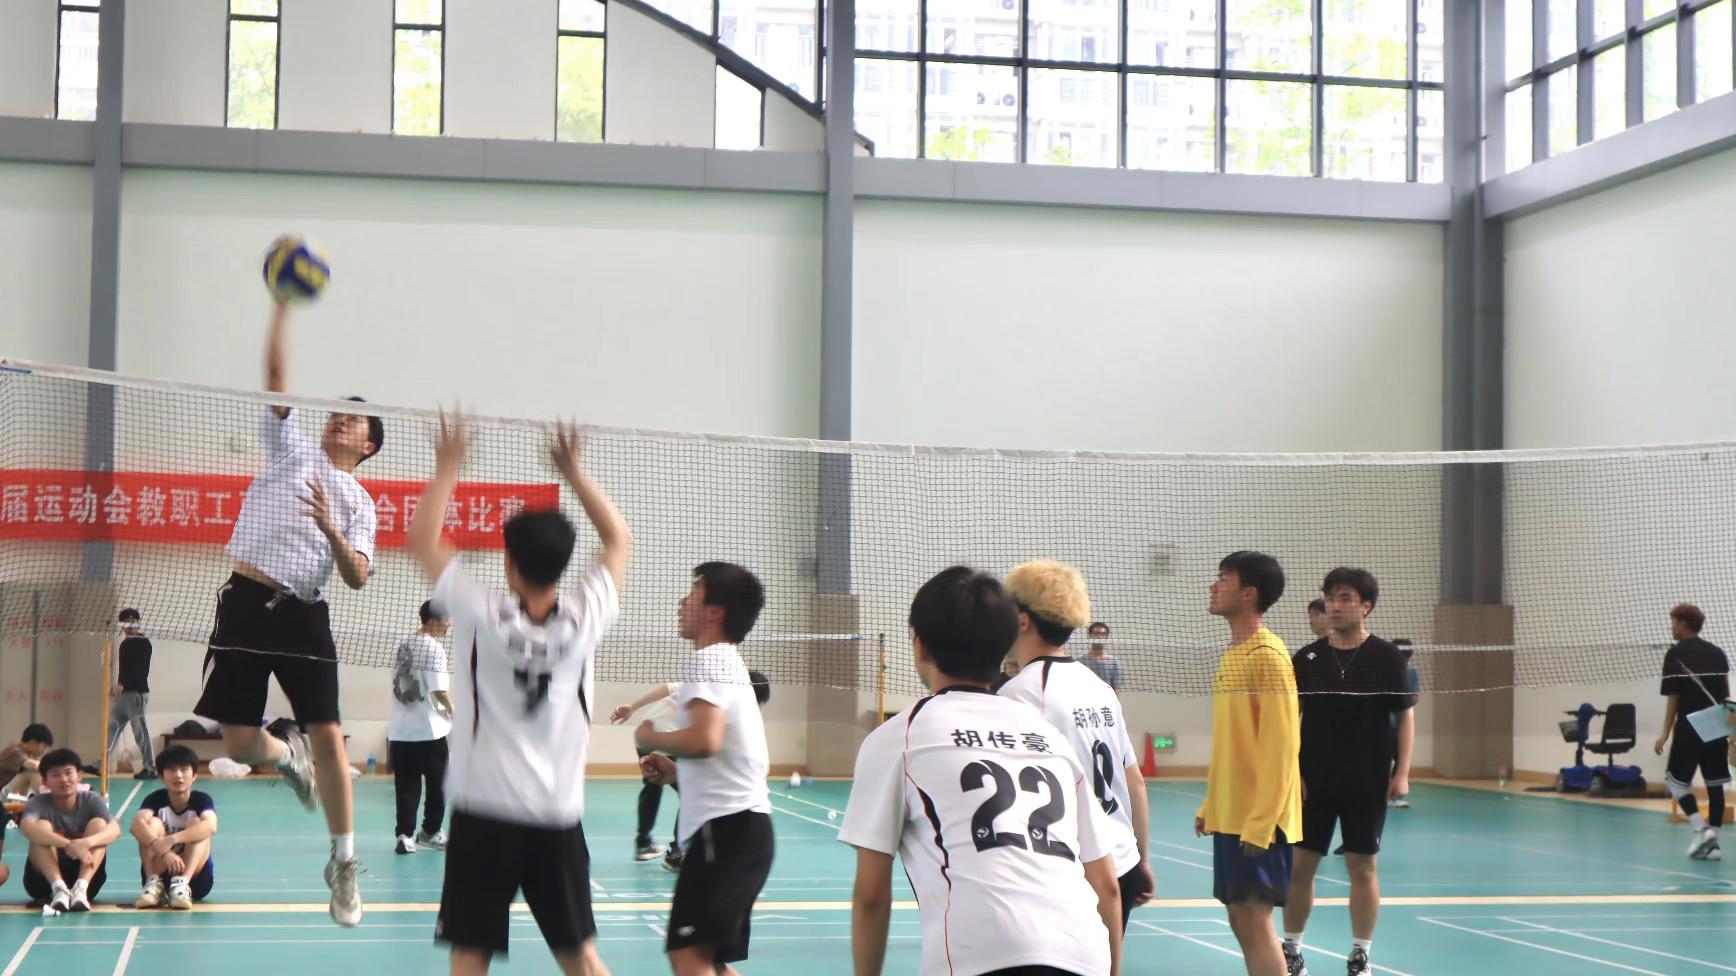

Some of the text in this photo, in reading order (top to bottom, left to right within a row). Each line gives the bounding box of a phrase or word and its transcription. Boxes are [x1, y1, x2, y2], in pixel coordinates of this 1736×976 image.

[950, 728, 1053, 754] 胡传豪
[960, 759, 1076, 863] 22
